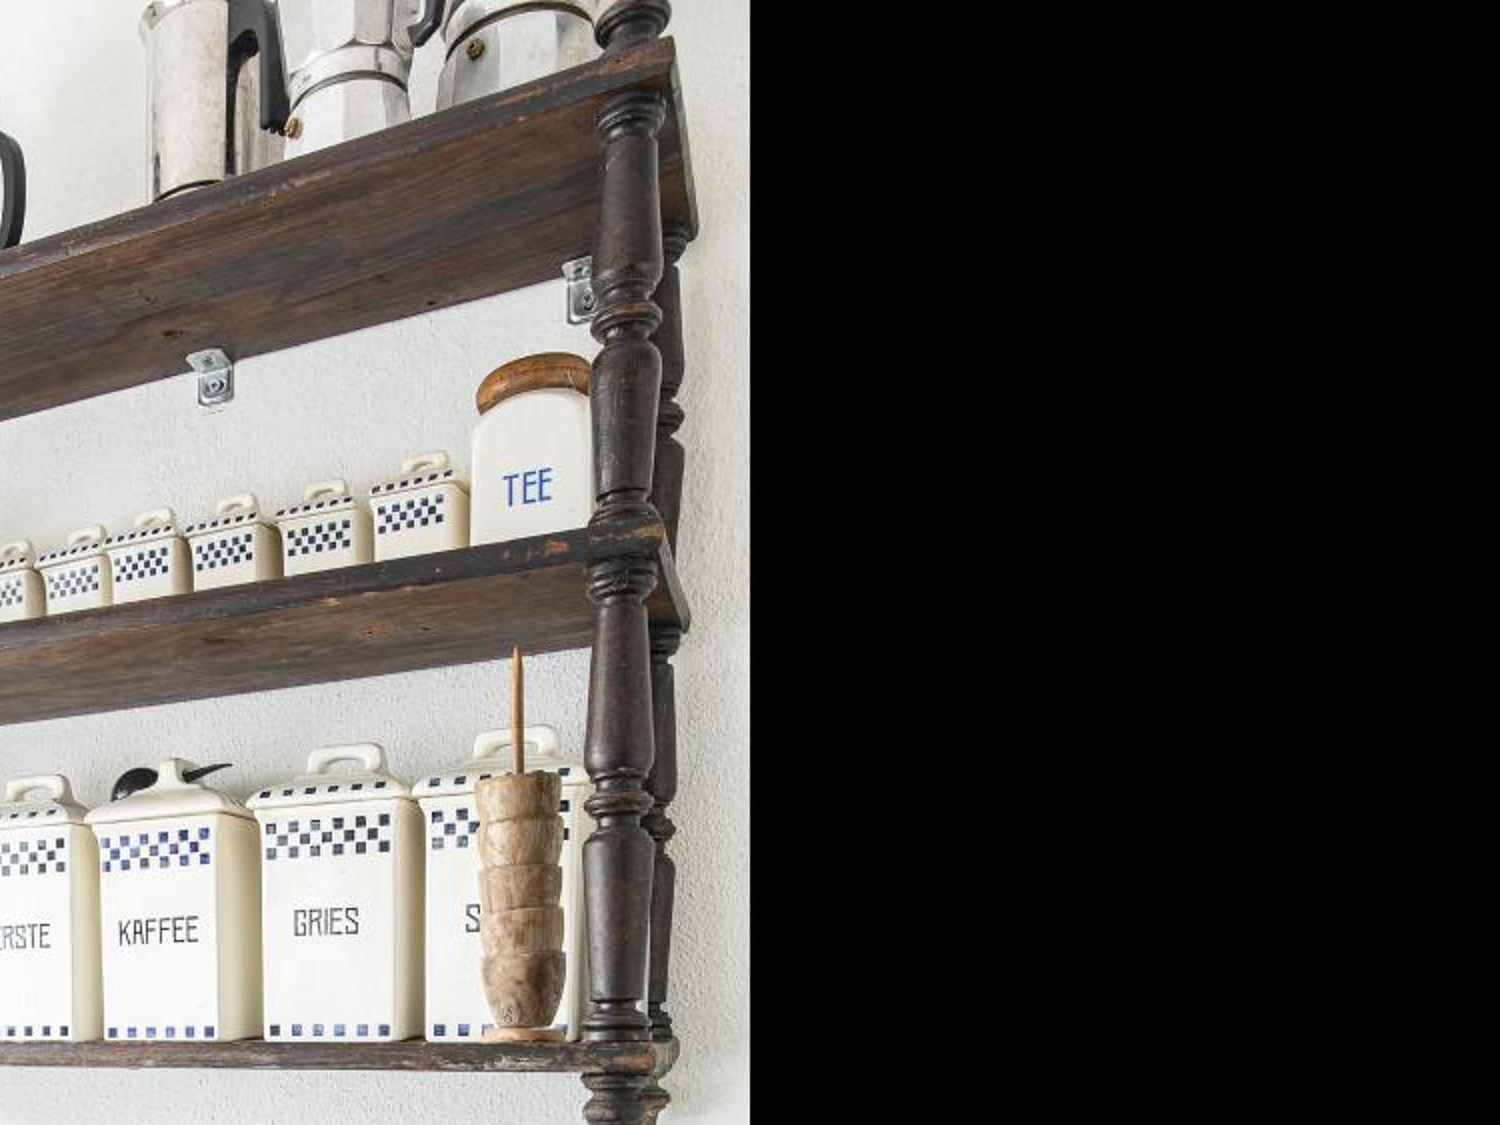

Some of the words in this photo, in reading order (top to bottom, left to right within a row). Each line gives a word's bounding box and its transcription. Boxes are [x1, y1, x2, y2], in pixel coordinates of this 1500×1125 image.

[502, 467, 552, 507] TEE
[118, 915, 200, 947] KAFFEE
[293, 906, 360, 937] GRIES
